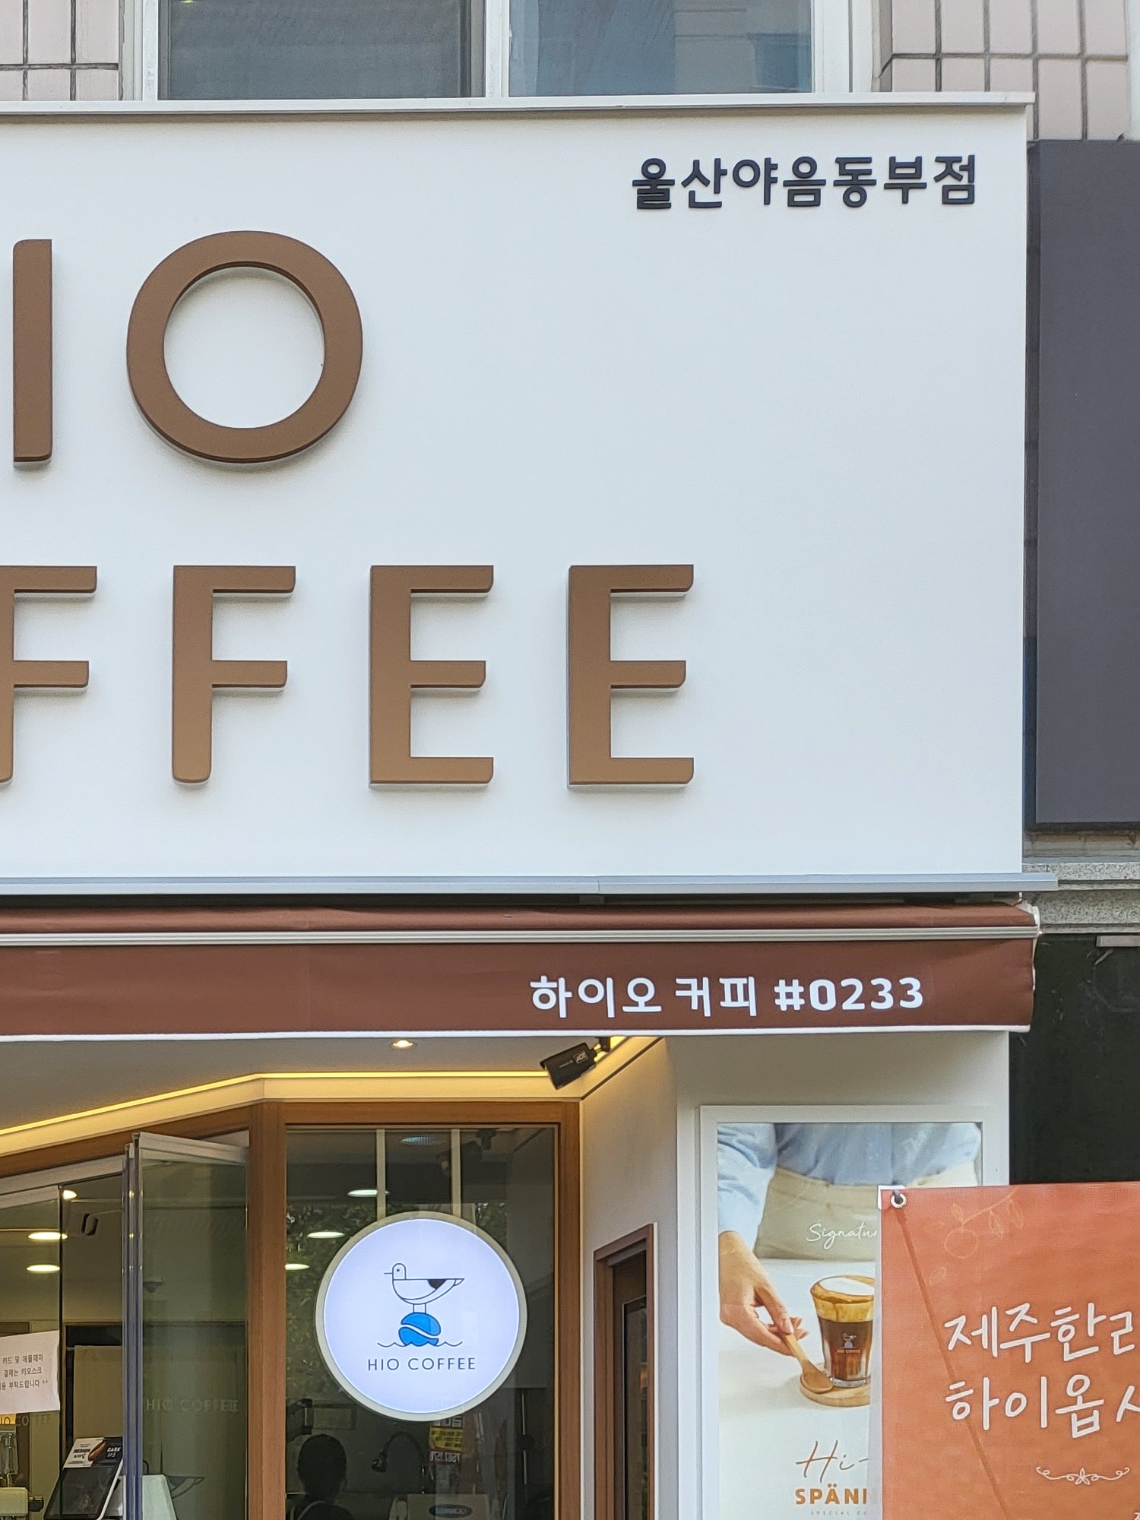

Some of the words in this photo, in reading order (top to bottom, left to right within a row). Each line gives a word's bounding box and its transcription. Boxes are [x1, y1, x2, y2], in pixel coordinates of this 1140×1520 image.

[632, 155, 976, 210] 울산야음동부점
[531, 975, 662, 1018] 하이오
[675, 975, 757, 1017] 커피
[774, 976, 923, 1012] #0233
[367, 1357, 401, 1372] HIO
[407, 1357, 477, 1372] COFFEE
